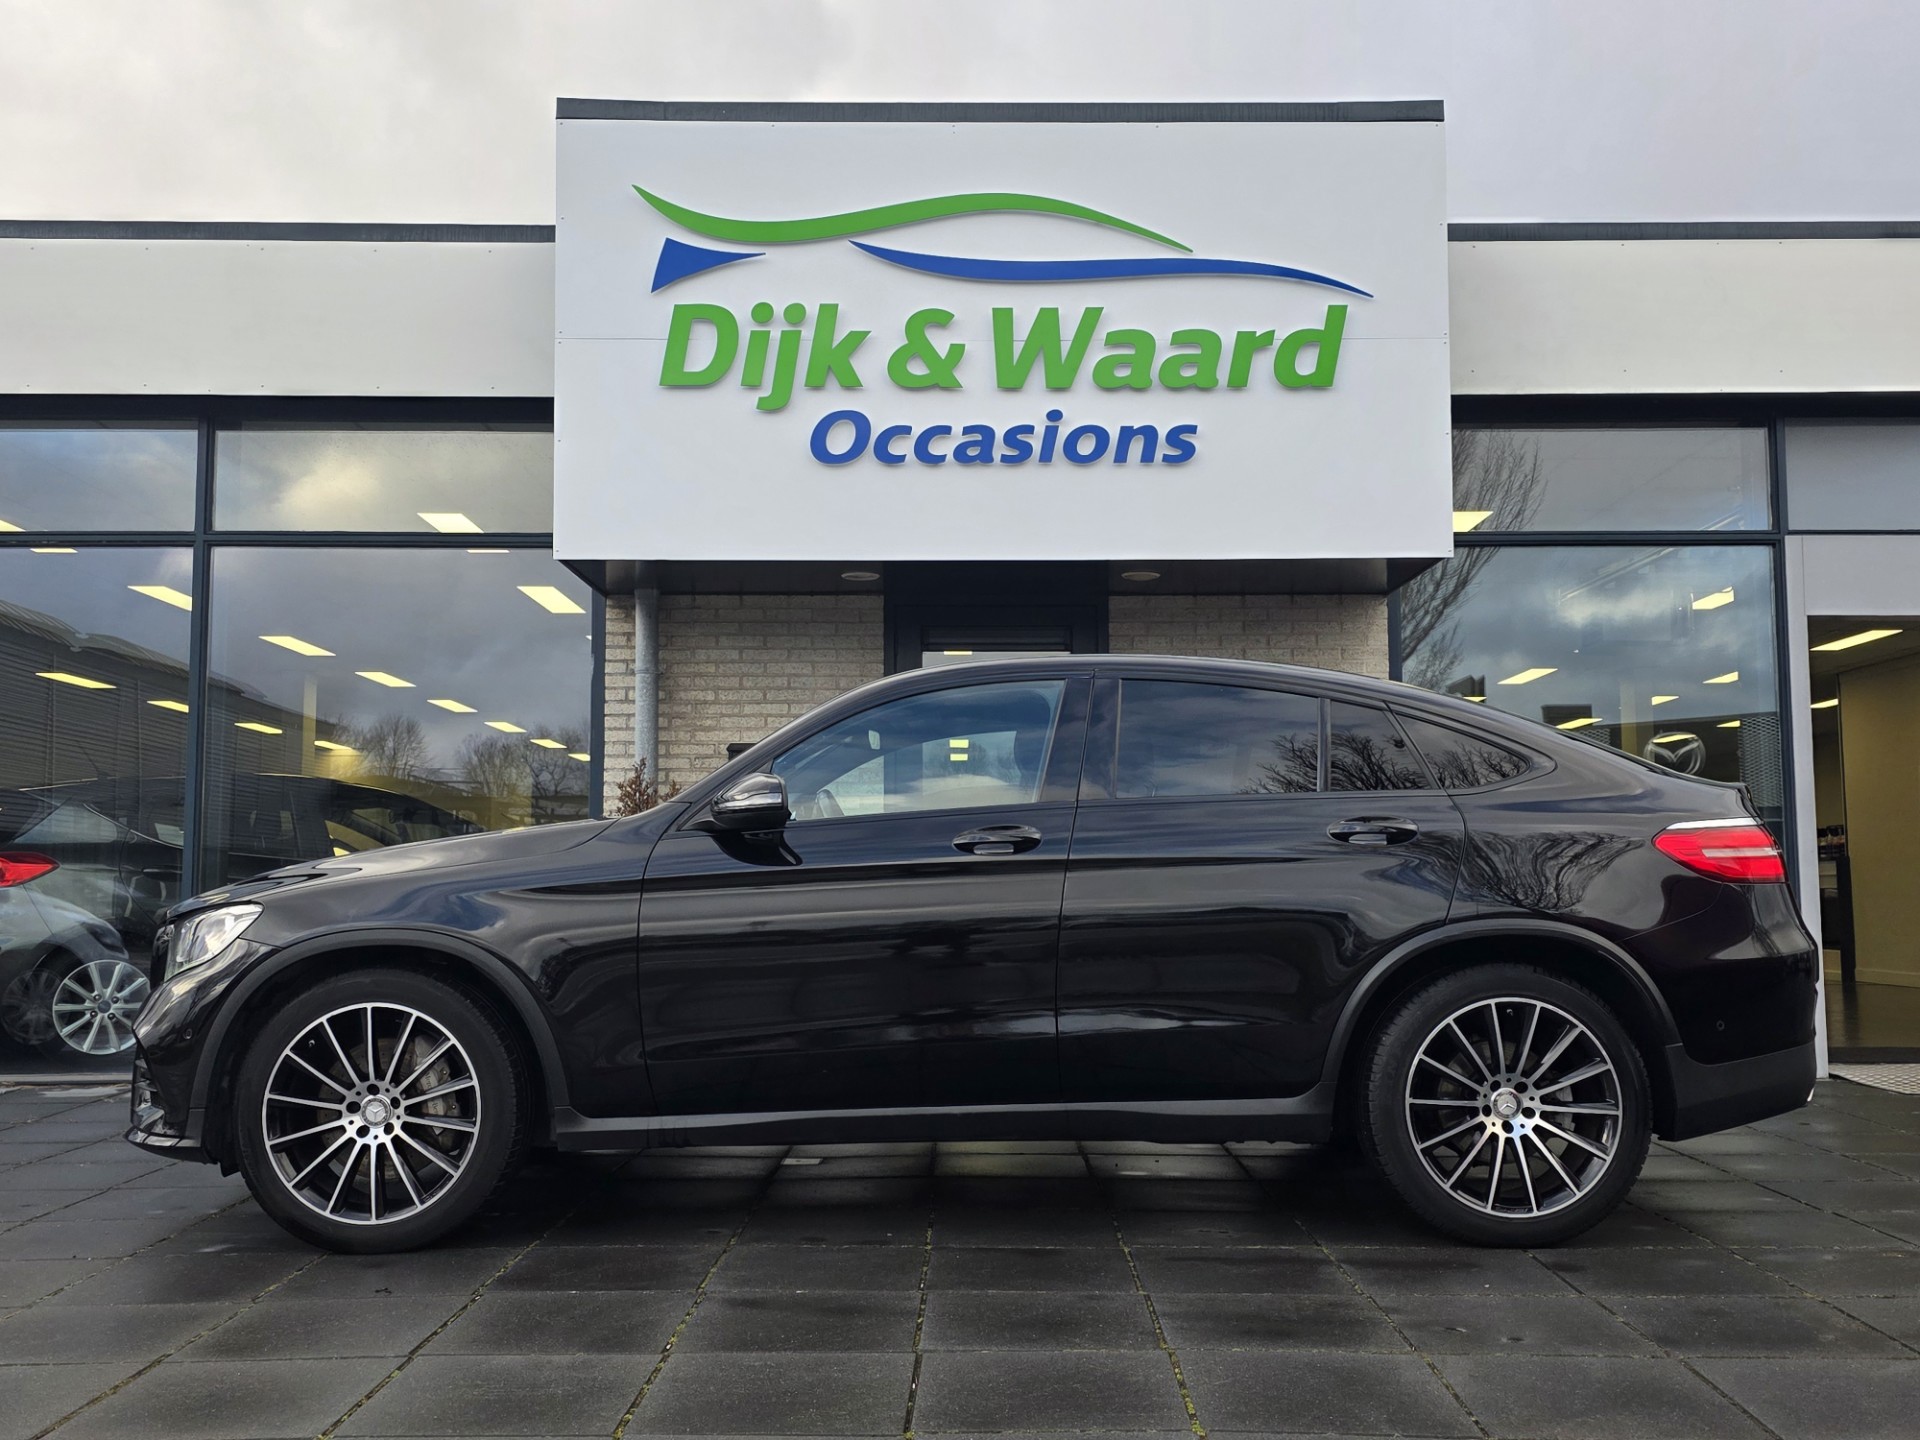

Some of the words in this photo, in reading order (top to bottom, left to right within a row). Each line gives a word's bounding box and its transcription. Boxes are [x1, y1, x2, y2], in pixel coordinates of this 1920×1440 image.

[660, 303, 869, 411] Dijk
[887, 307, 965, 389] &
[992, 304, 1348, 389] Waard
[810, 409, 1198, 465] Occasions
